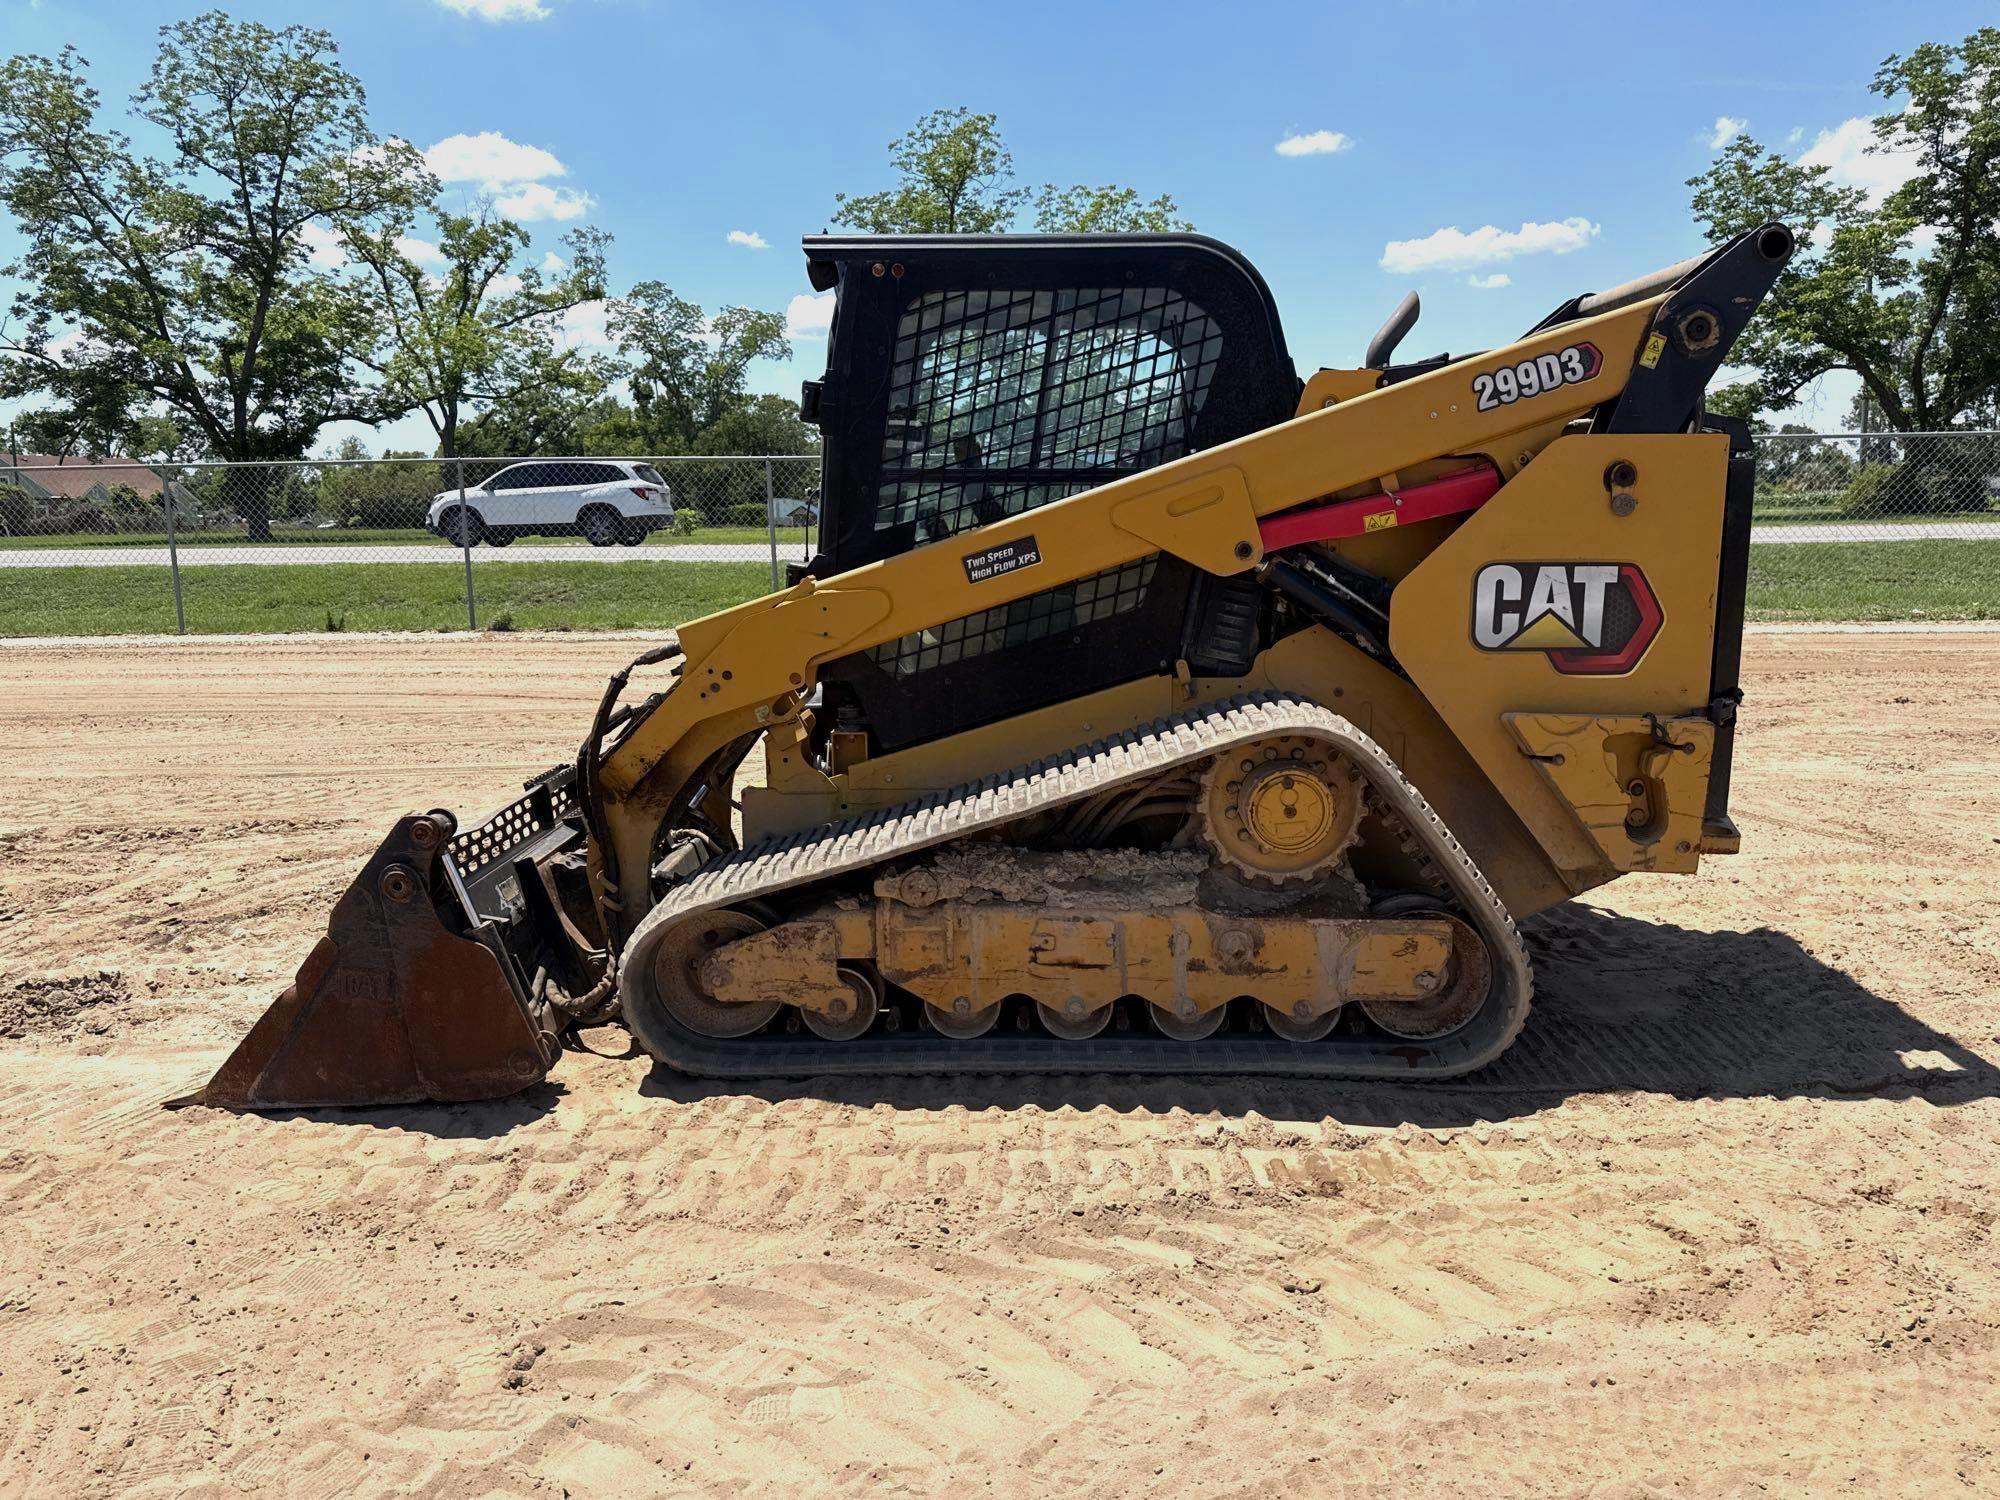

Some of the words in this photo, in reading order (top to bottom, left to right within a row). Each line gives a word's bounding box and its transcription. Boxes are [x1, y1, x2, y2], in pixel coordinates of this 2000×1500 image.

[1473, 347, 1585, 411] 299D3
[967, 556, 986, 569] TWO
[987, 547, 1014, 562] SPEED
[971, 567, 992, 580] HIGH
[993, 560, 1016, 573] FLOW
[1018, 551, 1037, 566] XPS
[1475, 564, 1619, 648] CAT
